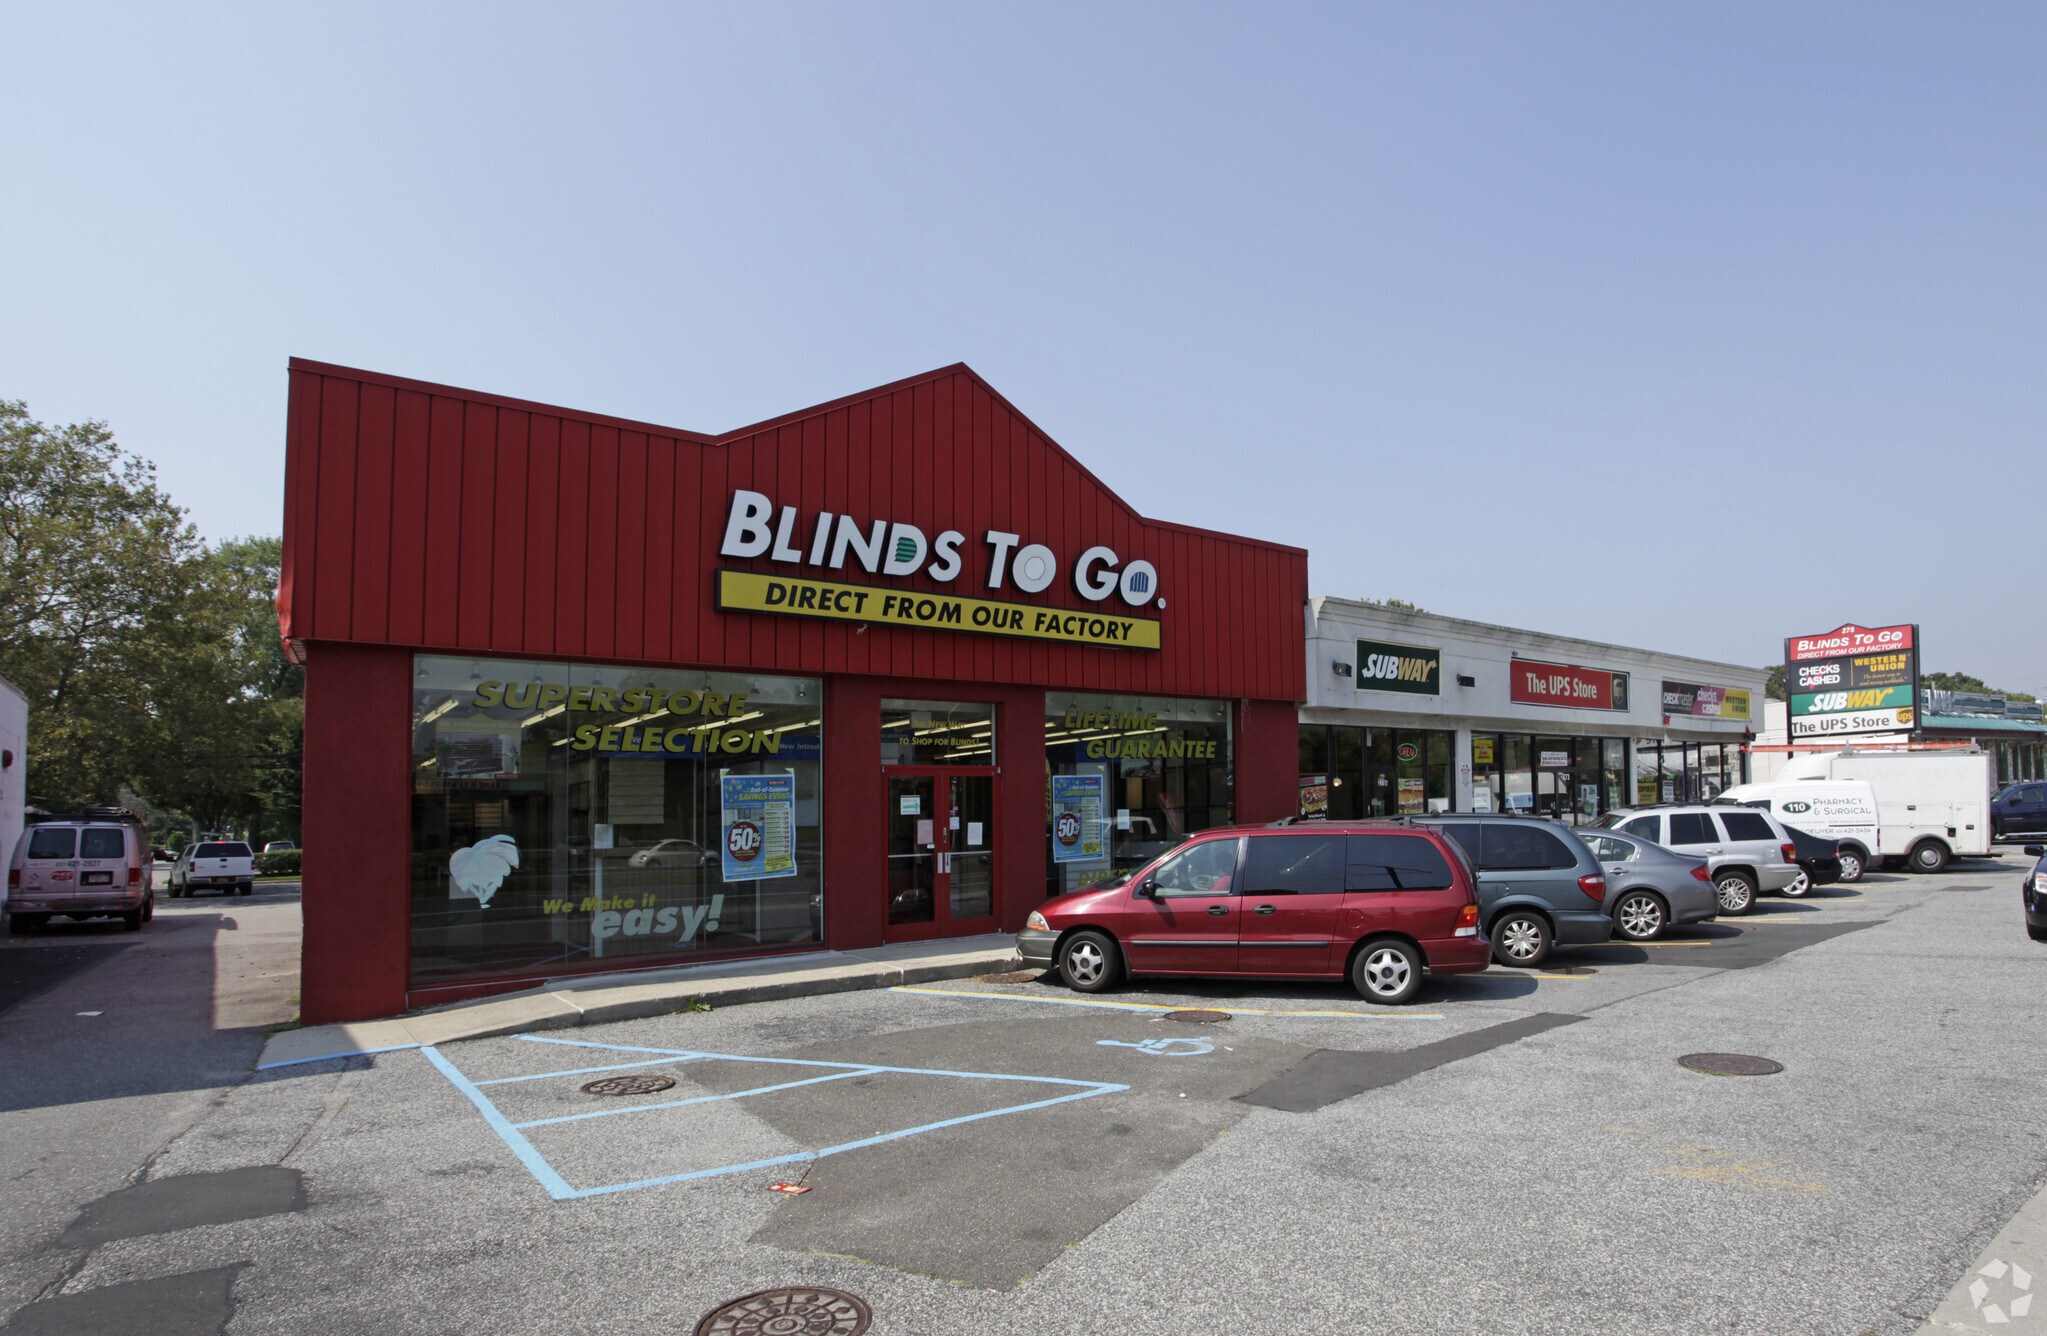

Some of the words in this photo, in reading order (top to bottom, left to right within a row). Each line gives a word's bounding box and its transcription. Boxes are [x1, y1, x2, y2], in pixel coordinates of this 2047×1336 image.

[719, 489, 966, 582] BLINDS
[982, 530, 1057, 593] TO
[764, 583, 868, 615] DIRECT
[882, 596, 962, 625] FROM
[972, 605, 1024, 631] OUR
[1034, 610, 1134, 642] FACTORY
[1798, 638, 1850, 651] BLINDS
[1854, 633, 1874, 645] TO
[1878, 631, 1903, 643] GO
[1797, 651, 1824, 660] DIRECT
[1825, 649, 1847, 657] FROM
[1848, 647, 1865, 655] OUR
[1866, 643, 1903, 652] FACTORY
[1854, 654, 1907, 666] WESTERN
[1362, 654, 1437, 682] SUBWAY
[1799, 664, 1840, 676] CHECKS
[1870, 662, 1906, 672] UNION
[1526, 672, 1546, 694] The
[1549, 675, 1570, 696] UPS
[1573, 678, 1598, 699] Store
[1799, 675, 1840, 686] CASHED
[472, 680, 748, 717] SUPERSTORE
[1697, 688, 1717, 702] checks
[1725, 696, 1746, 704] WESTERN
[1808, 688, 1894, 712] SUBWAY
[1701, 701, 1720, 714] cashed
[1732, 705, 1746, 713] UNION
[1064, 710, 1158, 730] LIFETIME
[1792, 722, 1816, 734] The
[1820, 718, 1848, 731] UPS
[1853, 716, 1890, 729] Store
[1897, 712, 1913, 724] ups
[571, 724, 783, 754] SELECTION
[911, 737, 932, 745] SHOP
[1086, 740, 1217, 759] GUARANTEE
[1399, 747, 1415, 757] OPEN
[1788, 803, 1806, 811] 110
[1814, 807, 1820, 815] &
[1823, 807, 1871, 815] SURGICAL
[543, 899, 575, 914] We
[580, 895, 635, 912] Make
[641, 893, 657, 907] it
[591, 894, 725, 942] easy!
